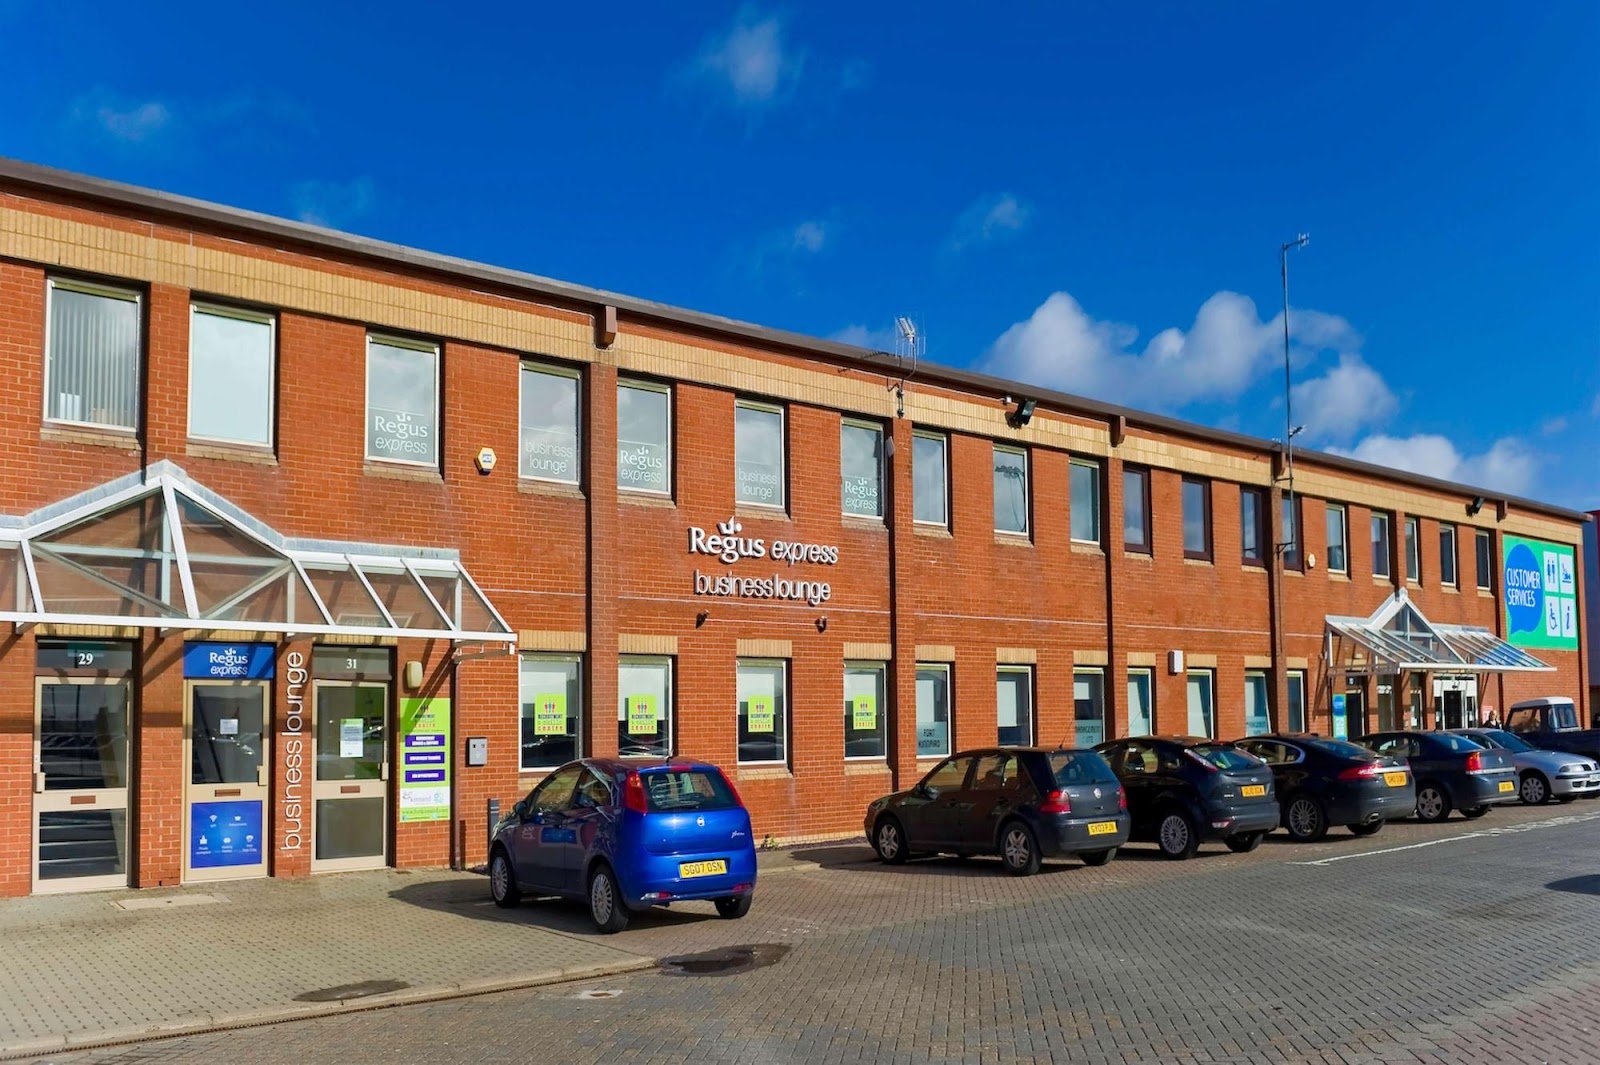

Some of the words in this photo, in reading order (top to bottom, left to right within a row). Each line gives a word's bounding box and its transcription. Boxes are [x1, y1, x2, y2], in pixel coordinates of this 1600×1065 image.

[375, 415, 428, 439] Regus
[375, 437, 427, 454] express
[526, 440, 573, 458] business
[530, 455, 567, 475] lounge
[620, 449, 662, 470] Regus
[621, 468, 662, 483] express
[738, 467, 777, 485] business
[743, 482, 773, 500] lounge
[845, 480, 878, 499] Regus
[845, 497, 878, 511] express
[688, 526, 766, 564] Regus
[770, 540, 839, 566] express
[1506, 567, 1541, 590] CUSTOMER
[1507, 588, 1536, 608] SERVICES
[78, 652, 94, 665] 29
[209, 651, 249, 667] Regus
[346, 658, 358, 669] 31
[210, 664, 248, 677] express
[683, 863, 705, 876] SG07
[707, 861, 723, 873] OSN
